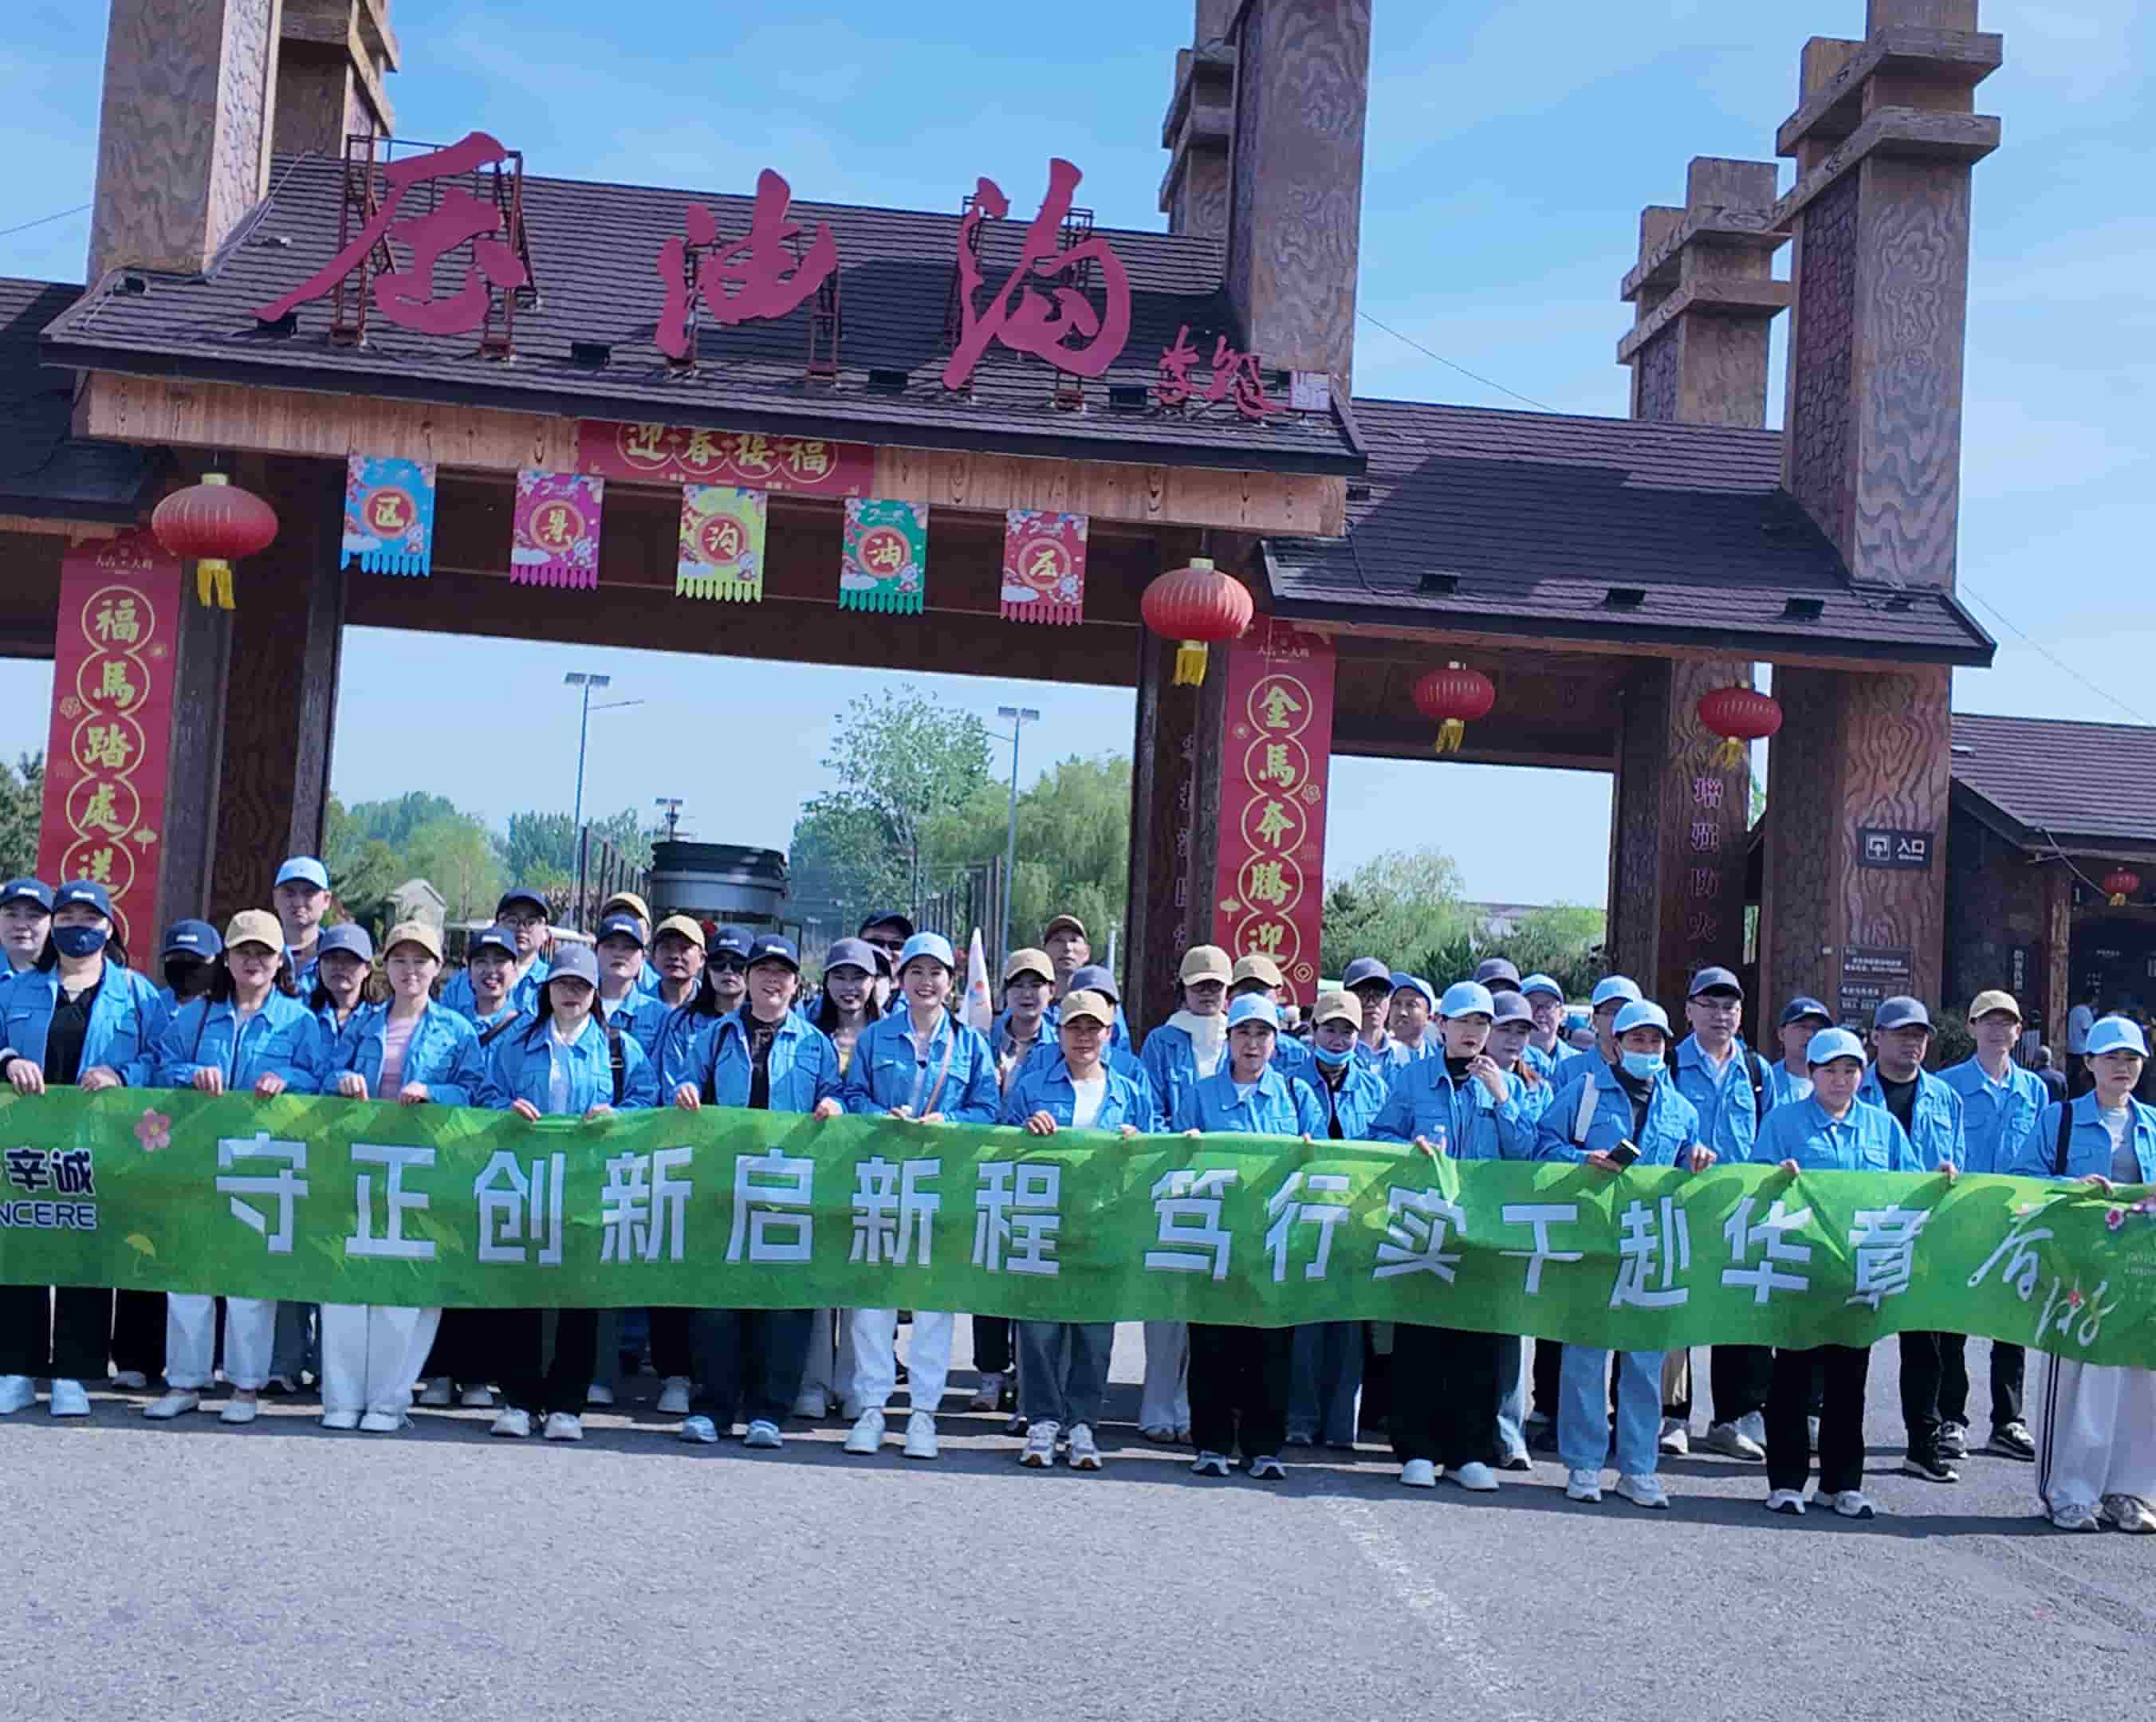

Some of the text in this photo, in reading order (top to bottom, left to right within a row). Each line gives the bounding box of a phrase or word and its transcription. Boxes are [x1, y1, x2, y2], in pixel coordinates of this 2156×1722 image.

[705, 522, 739, 556] 沟
[866, 537, 902, 566] 油
[1249, 685, 1302, 1003] 金馬奔騰迎
[1686, 777, 1723, 966] 增强防火
[1897, 837, 1925, 855] 入口
[215, 1132, 1930, 1311] 守正创新启新程 笃行实干赴华章
